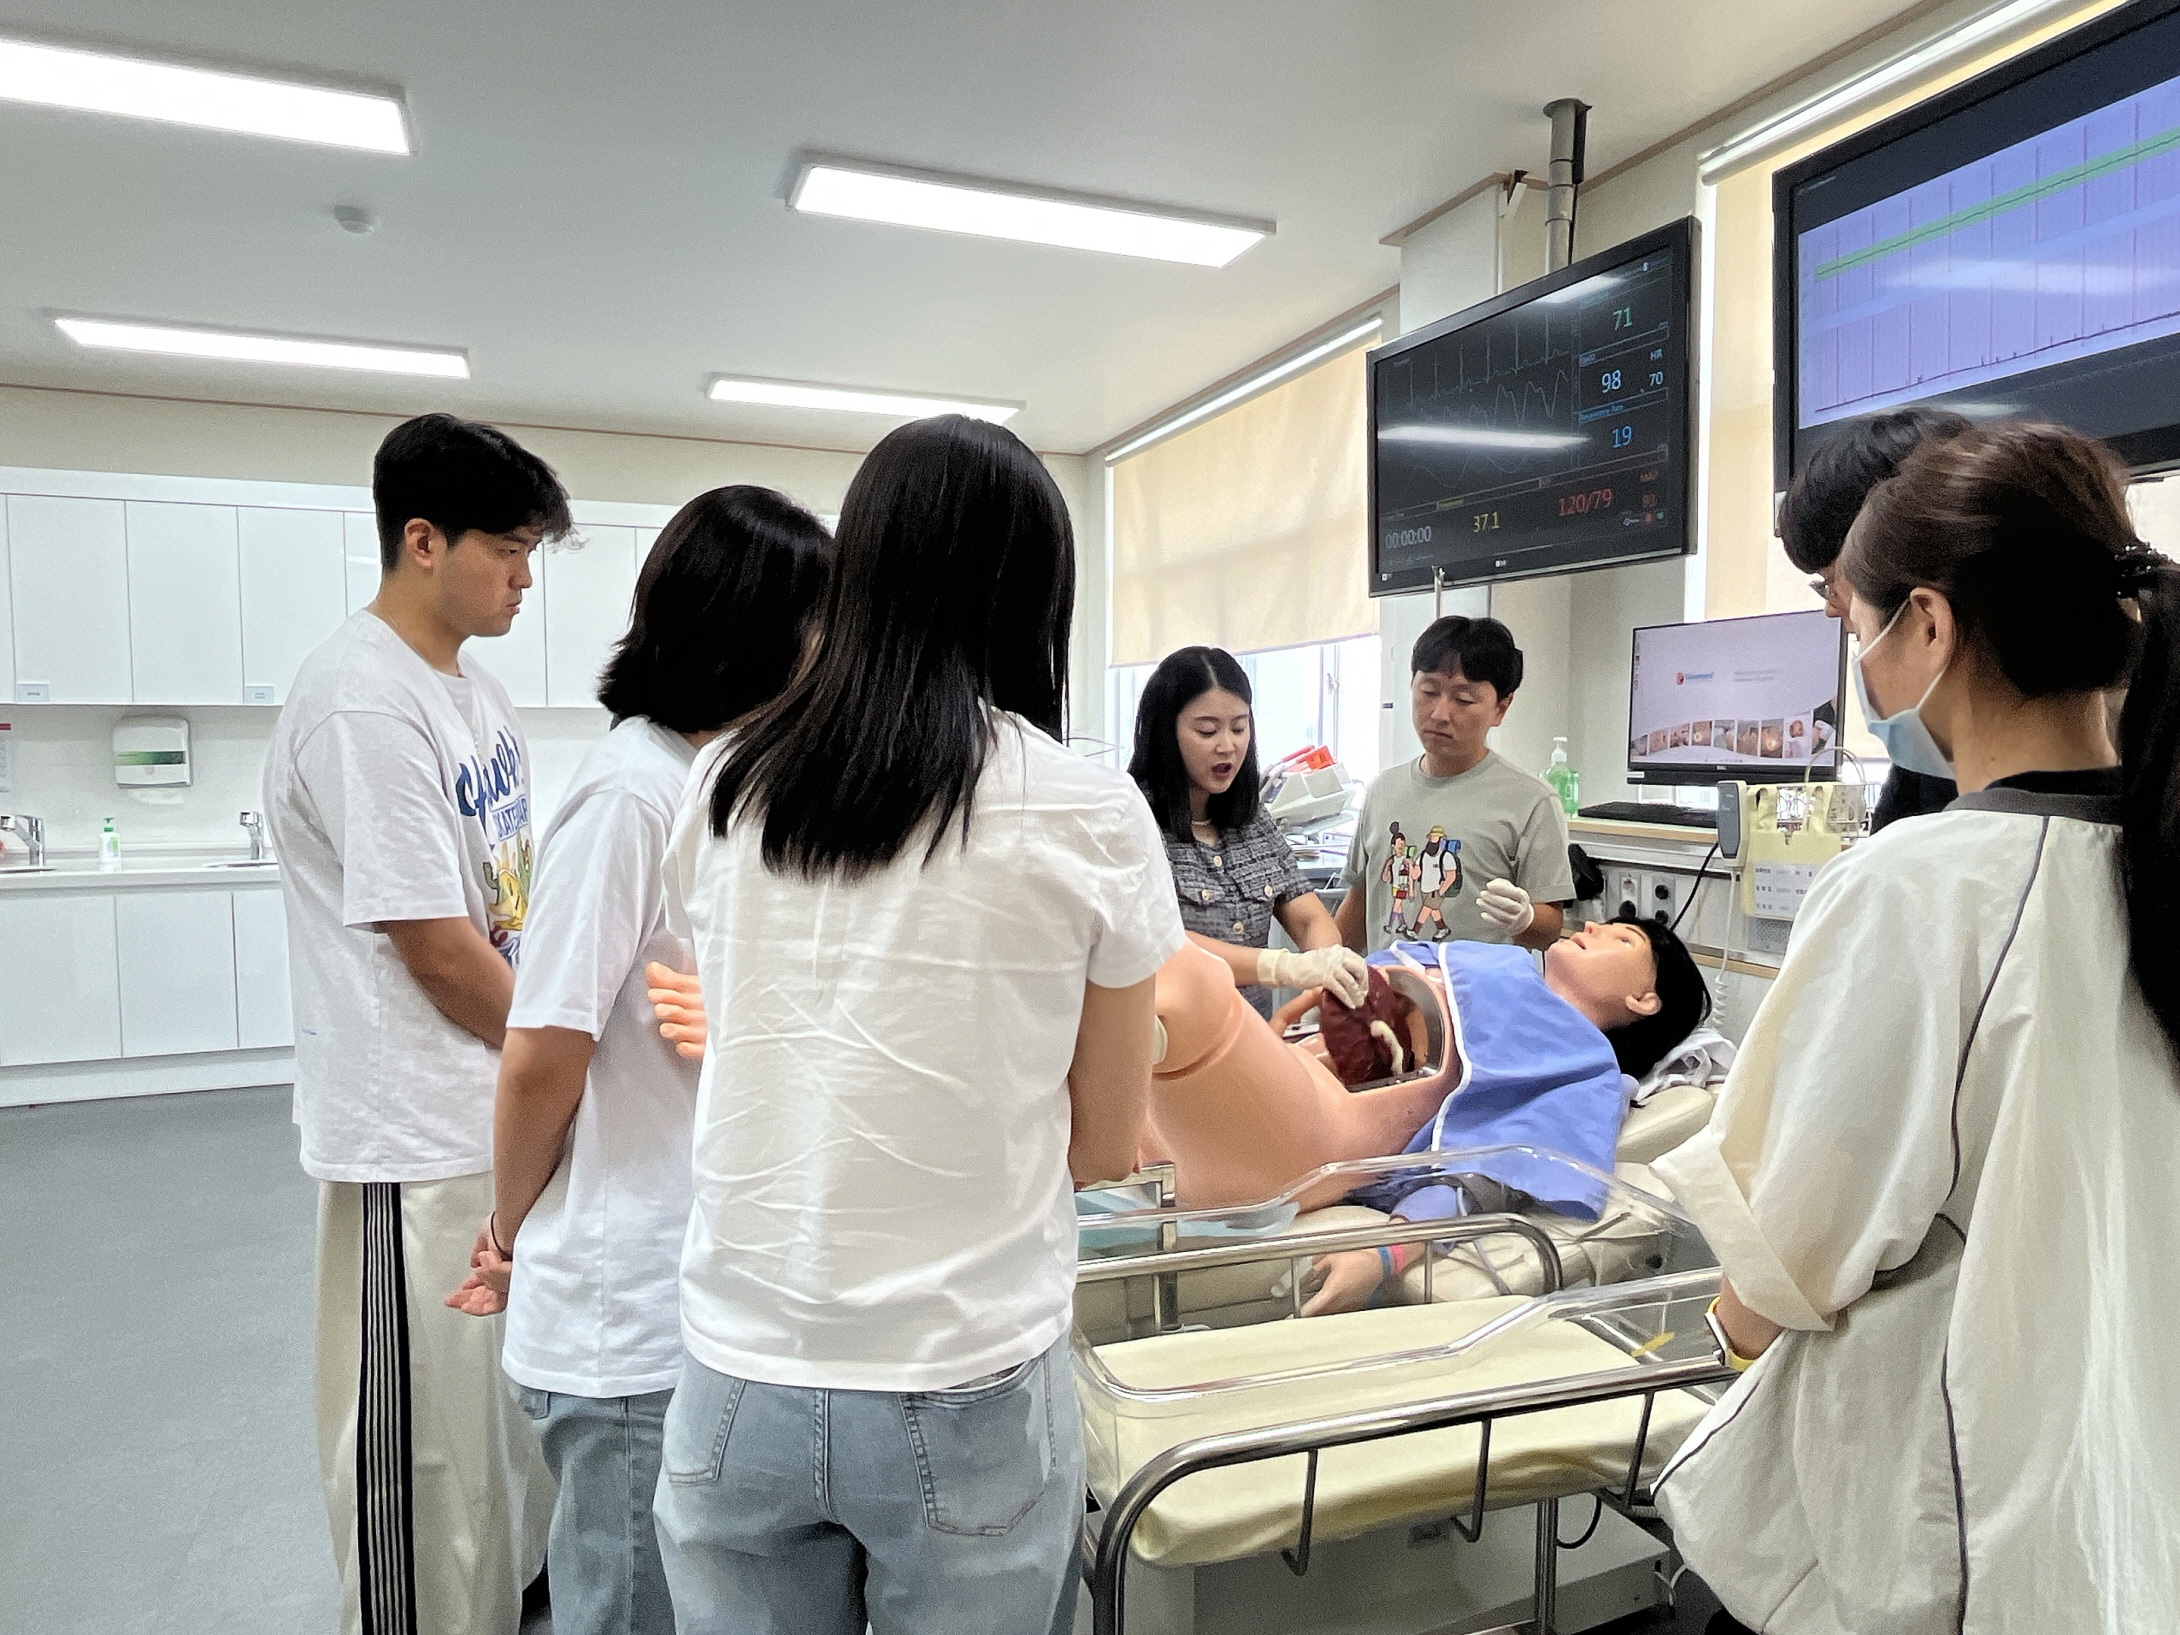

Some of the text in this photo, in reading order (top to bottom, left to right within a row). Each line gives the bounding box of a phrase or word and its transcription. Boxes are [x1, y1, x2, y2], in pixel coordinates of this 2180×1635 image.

[1612, 307, 1632, 331] 71
[1601, 369, 1663, 394] 98 70
[1612, 425, 1633, 448] 19
[1558, 488, 1612, 516] 120/79
[1385, 525, 1432, 549] 00:00:00
